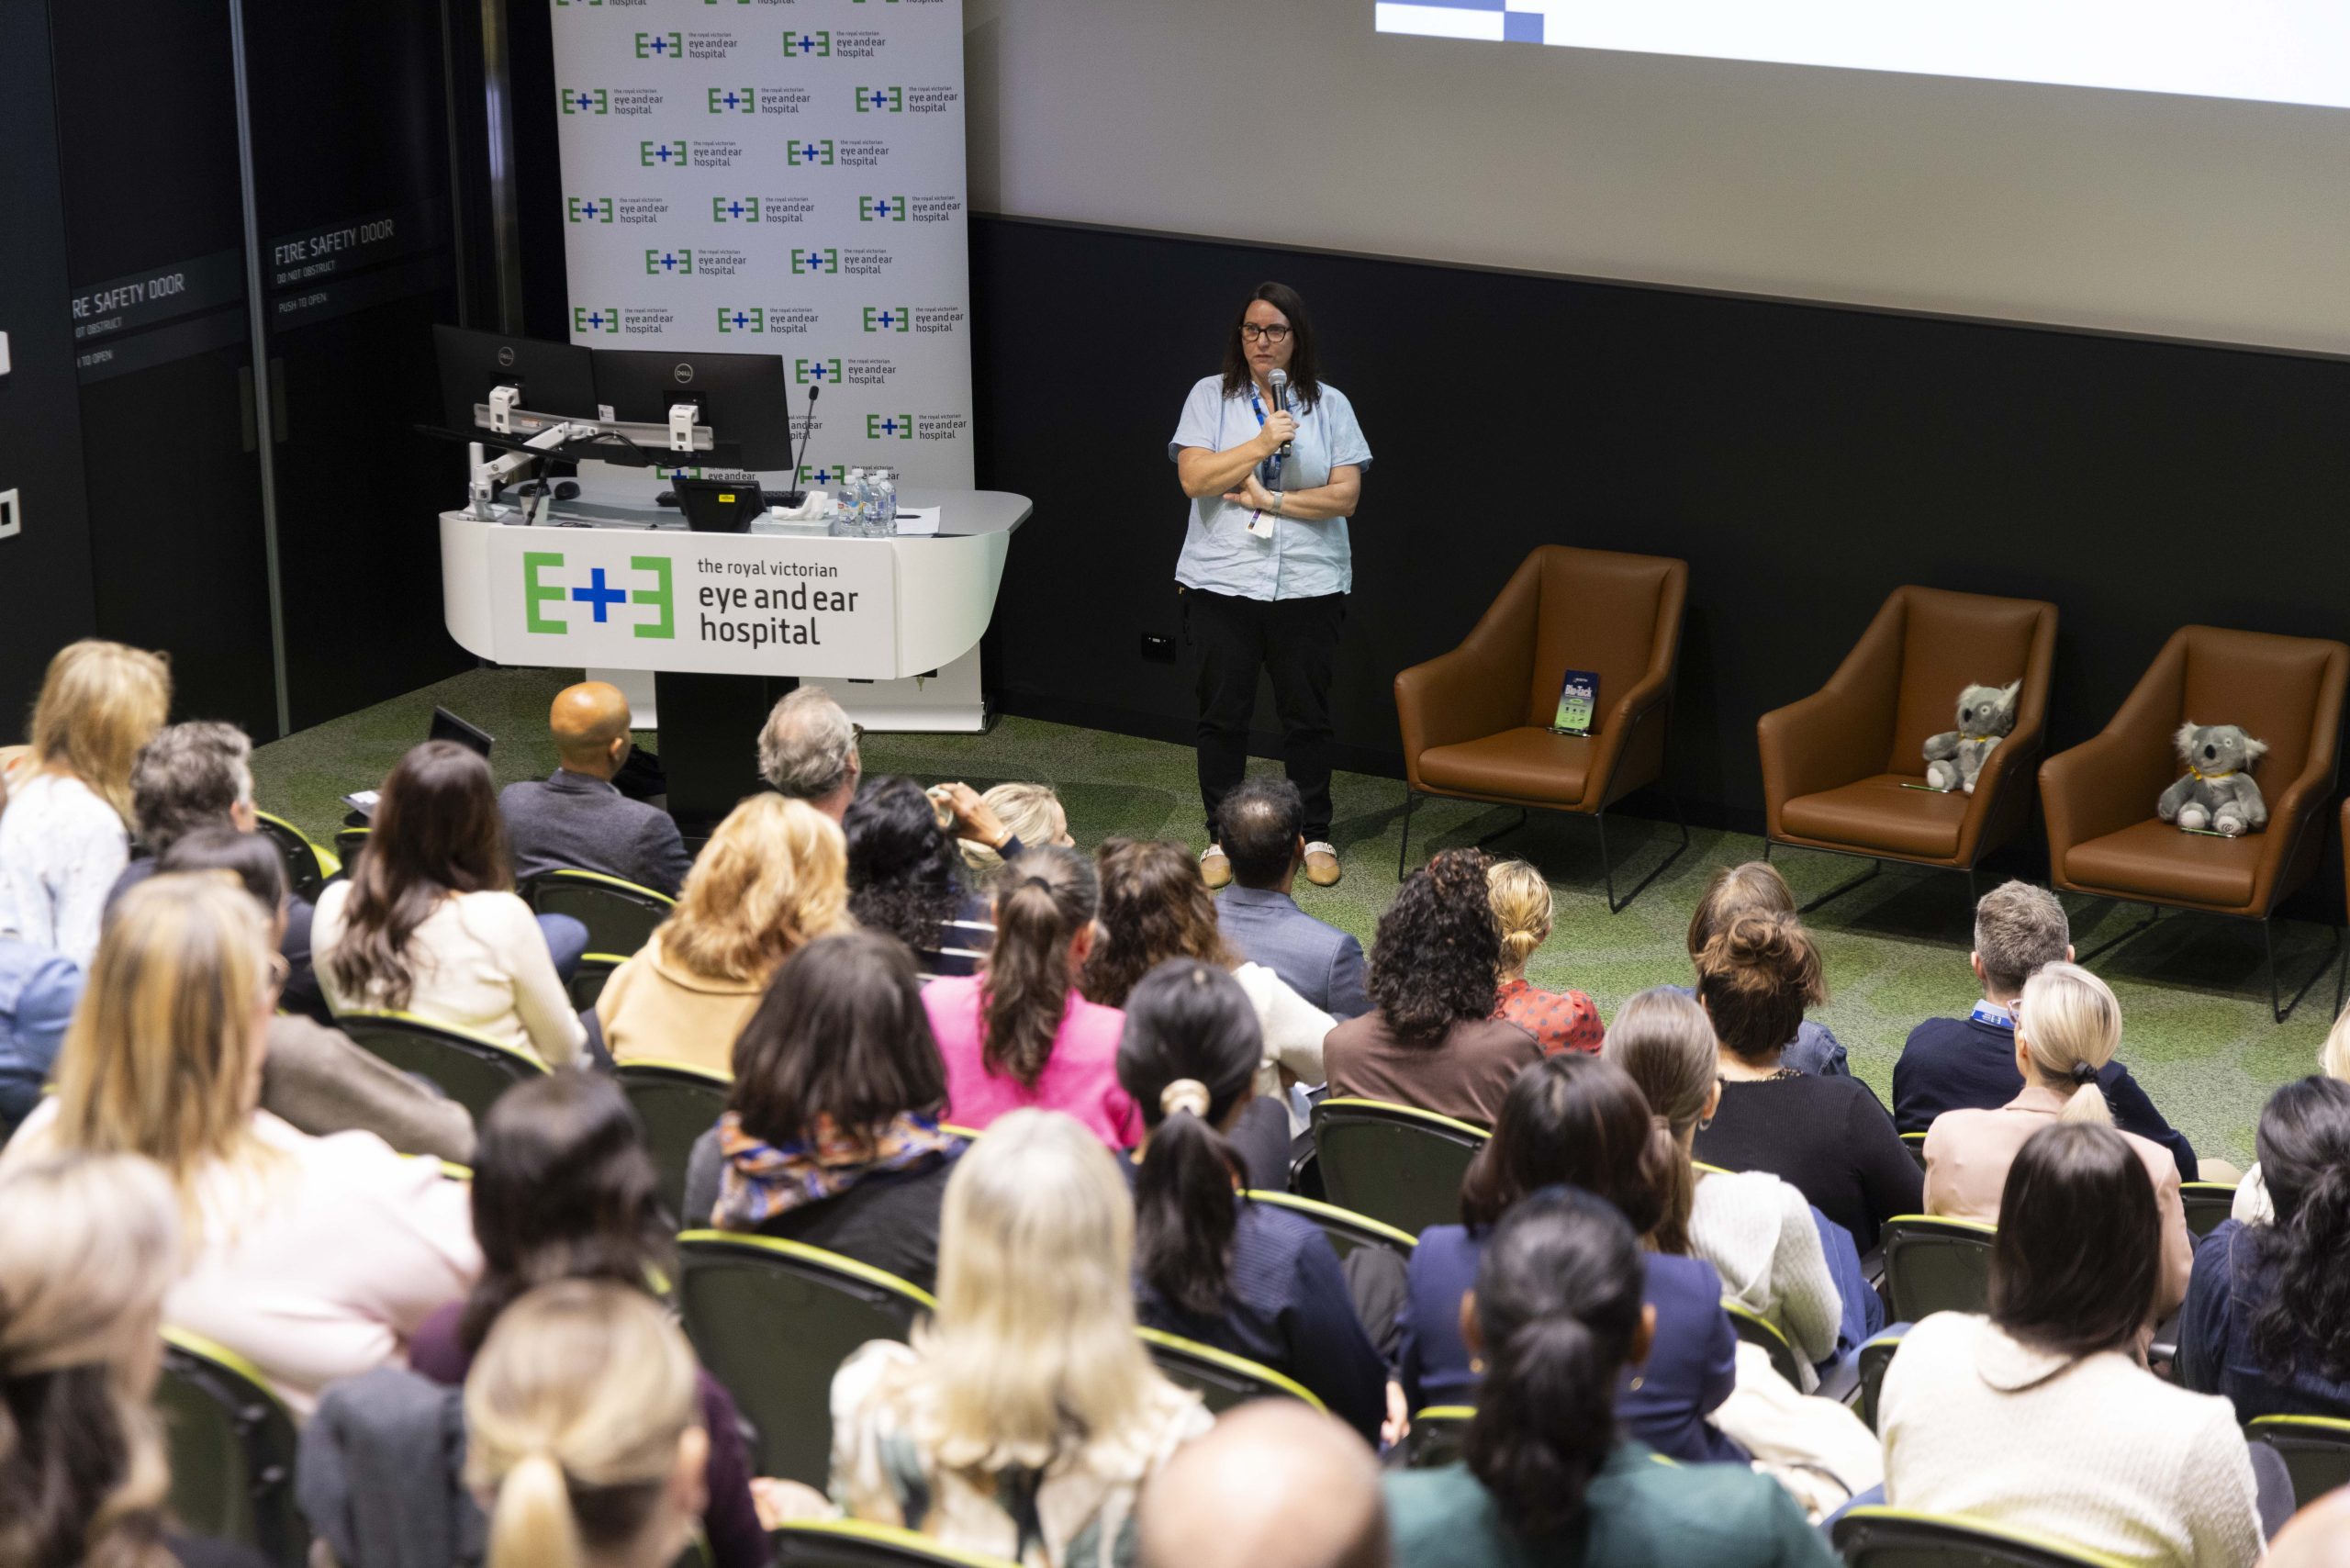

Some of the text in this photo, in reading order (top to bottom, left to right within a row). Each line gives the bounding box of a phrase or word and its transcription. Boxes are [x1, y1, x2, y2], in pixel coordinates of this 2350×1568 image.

[688, 39, 704, 50] eye
[706, 39, 722, 47] and
[837, 39, 852, 48] eye
[854, 37, 870, 46] and
[689, 49, 726, 59] hospital
[837, 48, 874, 58] hospital
[615, 96, 630, 106] eye
[632, 95, 648, 104] and
[762, 95, 777, 105] eye
[778, 94, 795, 102] and
[909, 94, 924, 103] eye
[926, 92, 943, 101] and
[615, 106, 652, 116] hospital
[762, 104, 799, 114] hospital
[910, 103, 946, 113] hospital
[694, 148, 709, 158] eye
[711, 147, 727, 155] and
[841, 147, 856, 157] eye
[857, 146, 874, 154] and
[694, 157, 731, 167] hospital
[841, 156, 878, 166] hospital
[620, 205, 635, 214] eye
[636, 203, 653, 212] and
[766, 204, 781, 214] eye
[782, 203, 799, 211] and
[912, 203, 927, 213] eye
[929, 202, 946, 210] and
[621, 214, 657, 224] hospital
[767, 213, 803, 223] hospital
[912, 212, 949, 222] hospital
[275, 218, 393, 264] FIRE SAFETY DOOR
[699, 257, 713, 266] eye
[715, 255, 732, 264] and
[845, 256, 859, 265] eye
[861, 254, 878, 263] and
[277, 261, 335, 284] DO NOT OBSTRUCT
[699, 266, 735, 276] hospital
[845, 265, 881, 275] hospital
[72, 274, 185, 319] RE SAFETY DOOR
[279, 293, 327, 312] PUSH TO OPEN
[625, 315, 640, 324] eye
[642, 313, 658, 322] and
[770, 315, 785, 324] eye
[787, 313, 803, 322] and
[916, 314, 931, 323] eye
[933, 312, 949, 321] and
[86, 316, 122, 335] OBSTRUCT
[625, 324, 663, 334] hospital
[770, 324, 808, 334] hospital
[916, 323, 953, 333] hospital
[82, 355, 91, 365] TO
[93, 350, 113, 364] OPEN
[848, 365, 863, 375] eye
[865, 364, 881, 373] and
[848, 375, 885, 385] hospital
[919, 421, 934, 431] eye
[935, 420, 952, 429] and
[919, 431, 957, 441] hospital
[698, 558, 837, 578] the royal victorian
[699, 582, 858, 613] eye and ear
[700, 612, 820, 649] hospital
